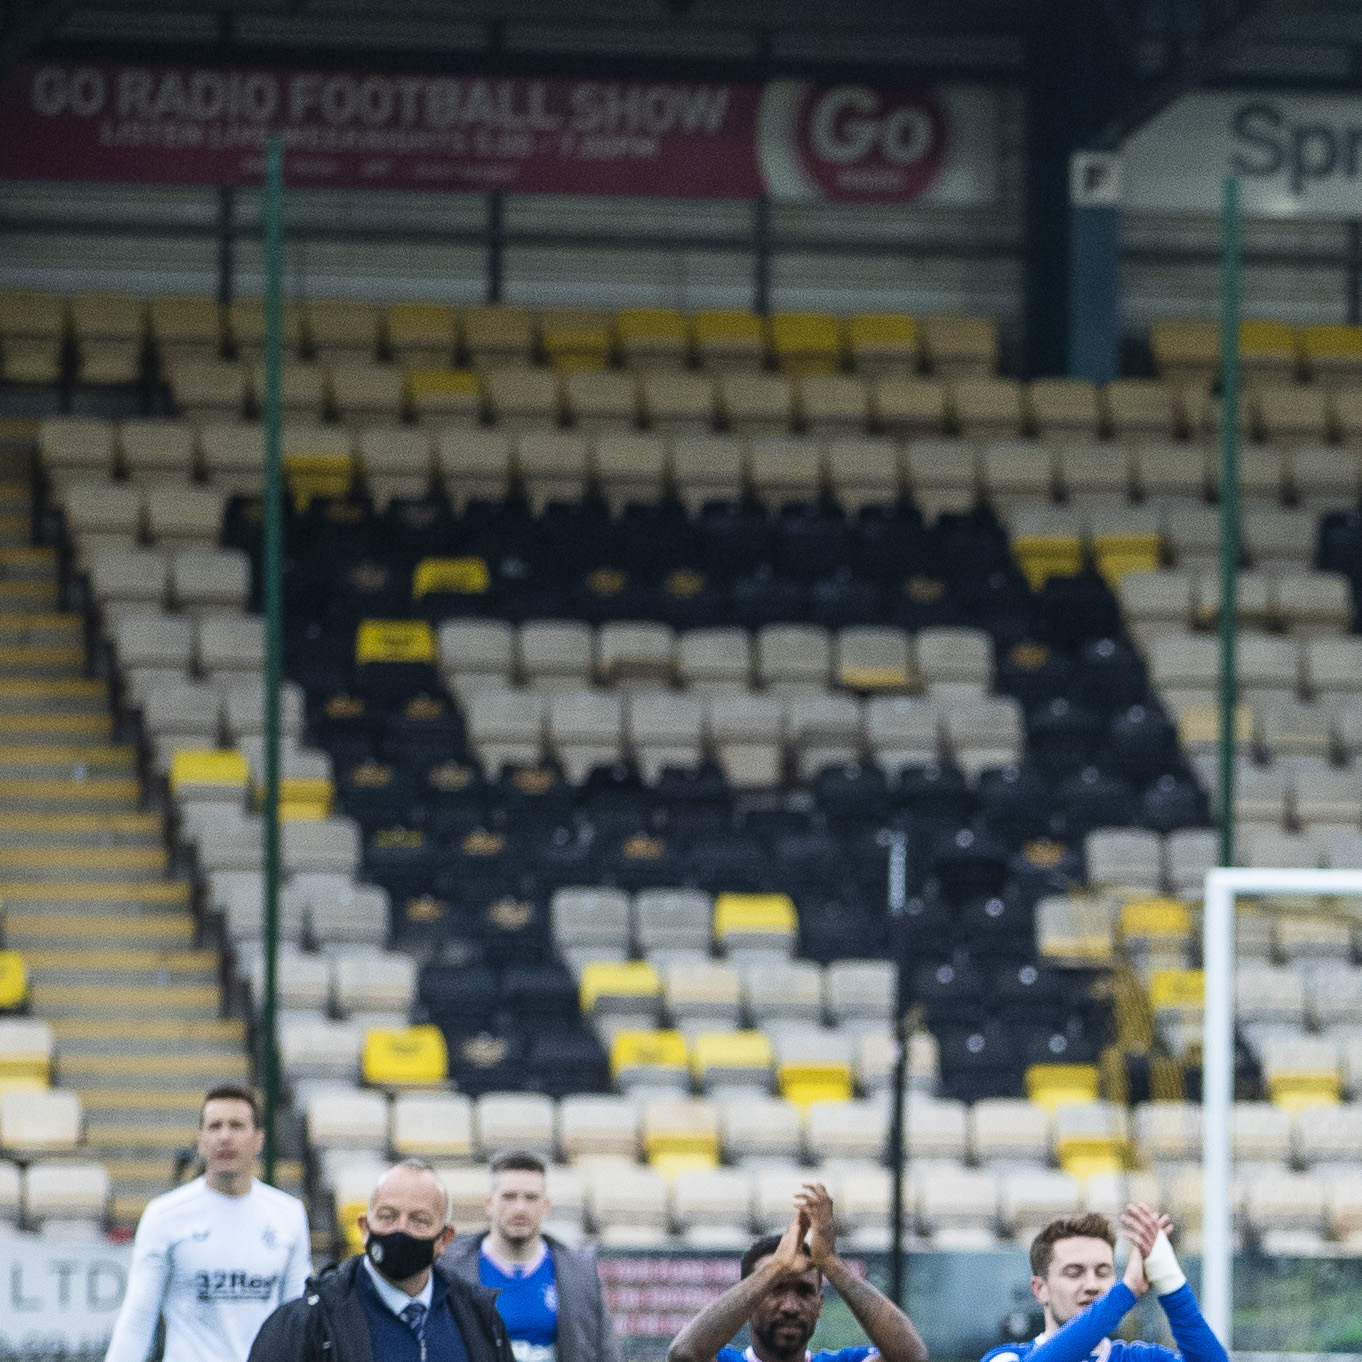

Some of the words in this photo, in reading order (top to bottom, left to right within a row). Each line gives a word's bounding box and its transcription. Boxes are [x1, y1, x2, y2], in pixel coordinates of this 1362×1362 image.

[32, 67, 105, 116] GO
[117, 69, 277, 121] RADIO
[289, 74, 563, 131] FOOTBALL
[569, 86, 731, 135] SHOW
[813, 85, 933, 166] Go
[10, 1259, 126, 1312] LTD
